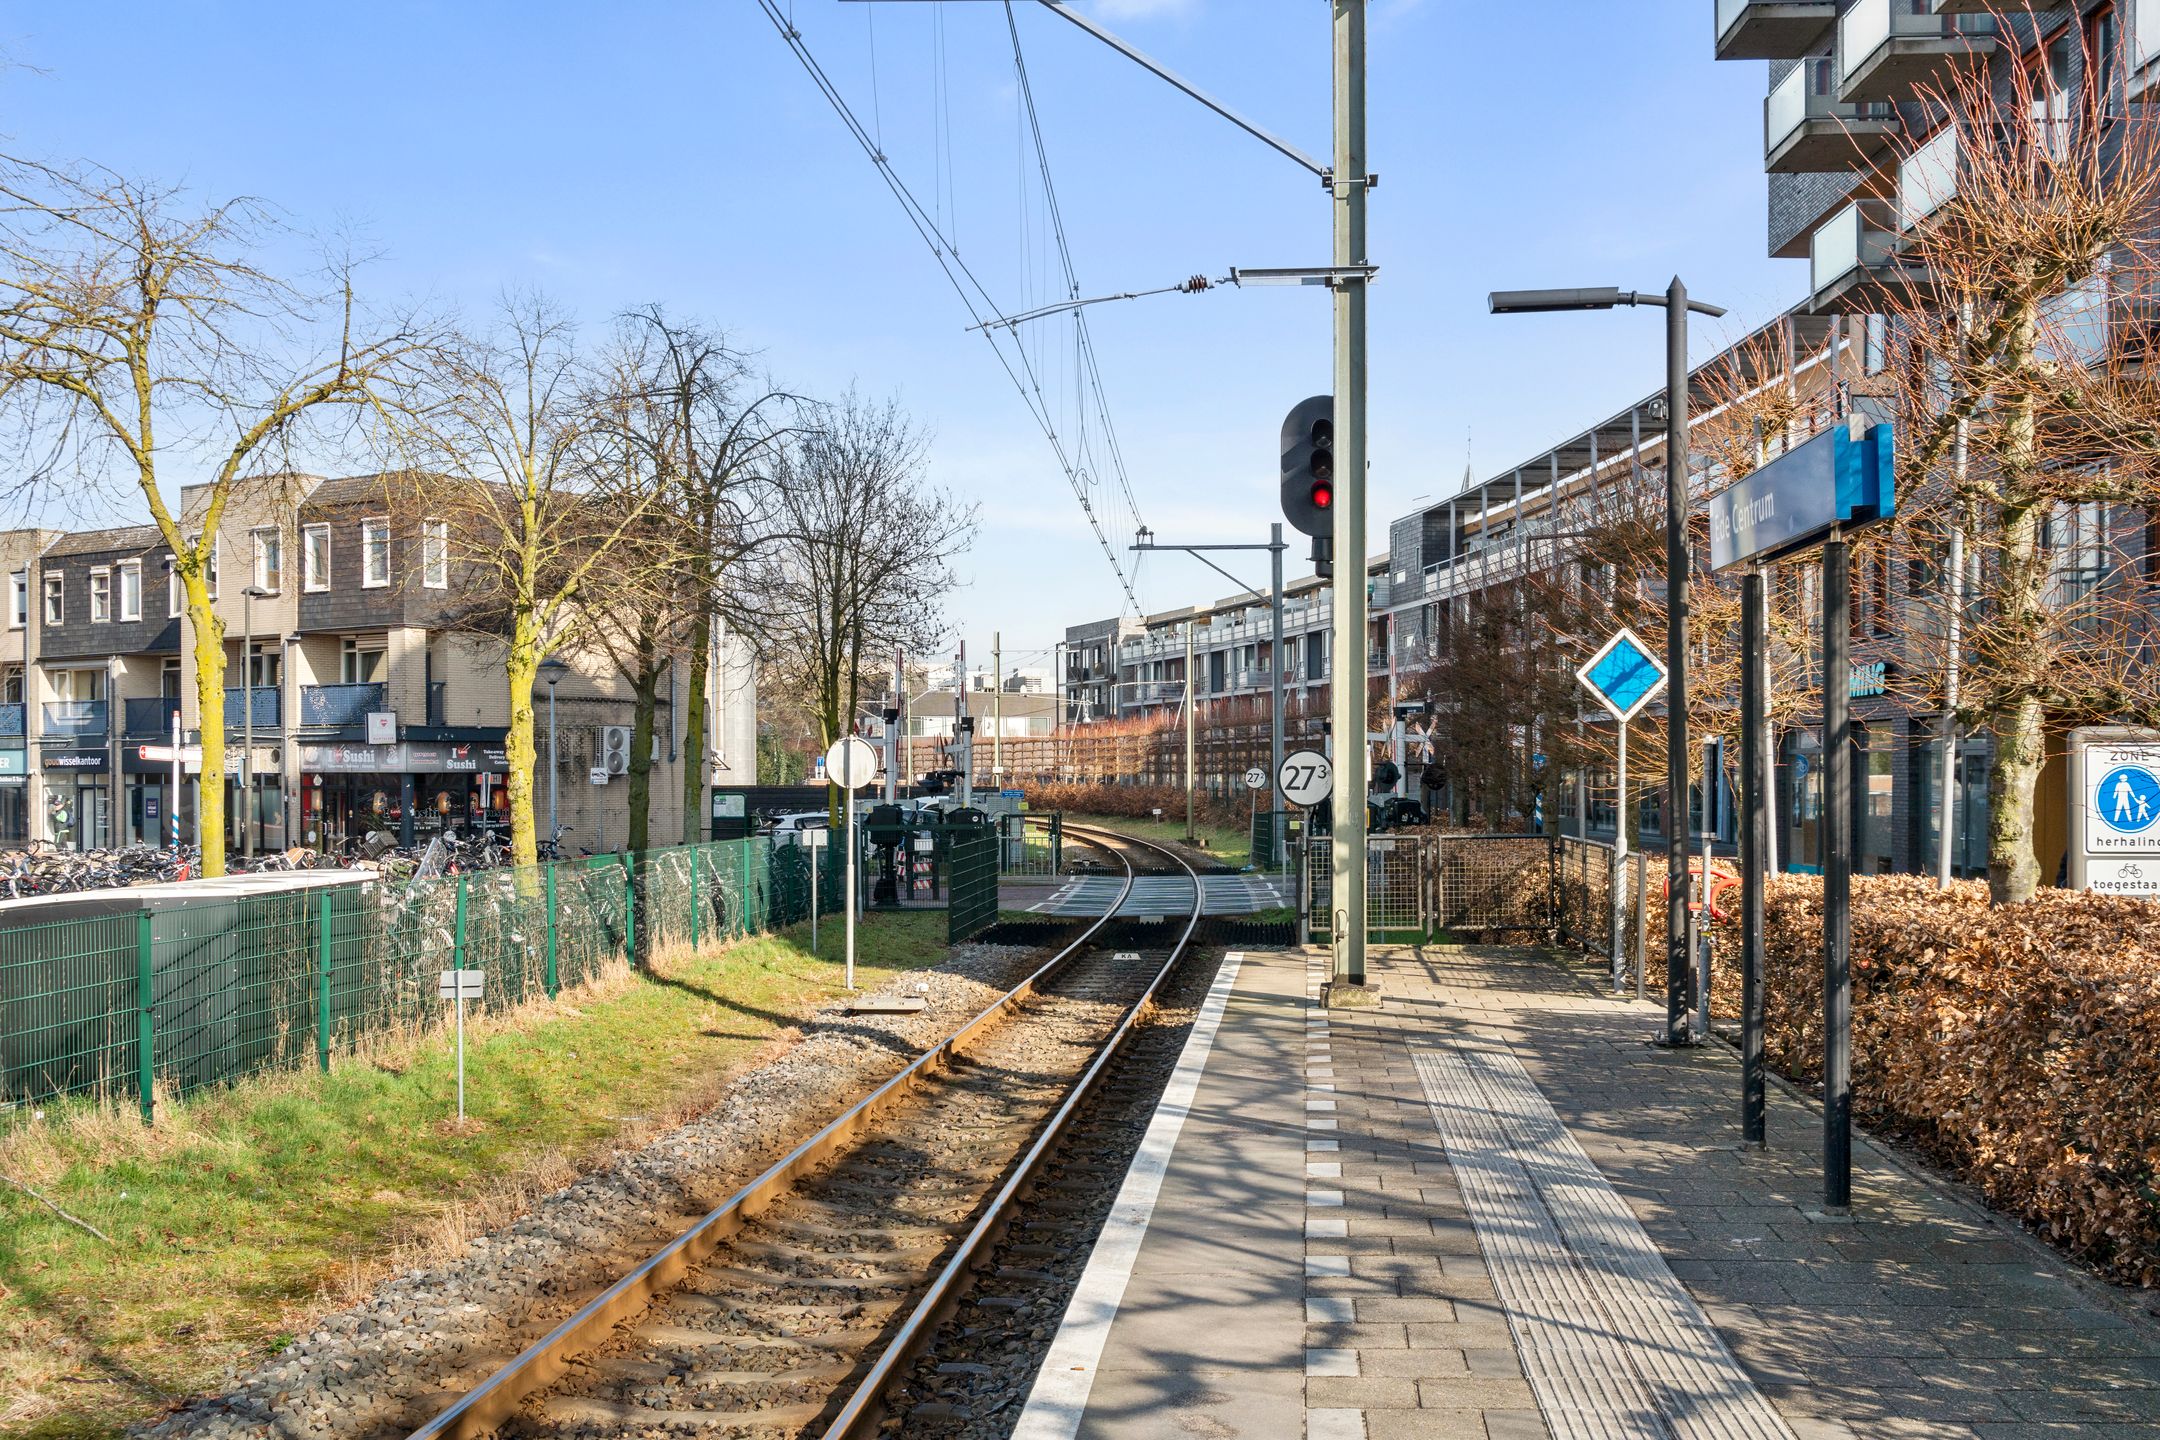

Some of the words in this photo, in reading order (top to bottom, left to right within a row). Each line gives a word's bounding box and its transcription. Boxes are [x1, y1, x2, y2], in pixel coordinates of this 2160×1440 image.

[1714, 510, 1730, 542] Ede
[1732, 492, 1774, 534] Centrum
[343, 749, 375, 763] Sushi
[2110, 751, 2149, 761] ZONE
[446, 759, 477, 770] Sushi
[2093, 880, 2158, 892] toegestaa
